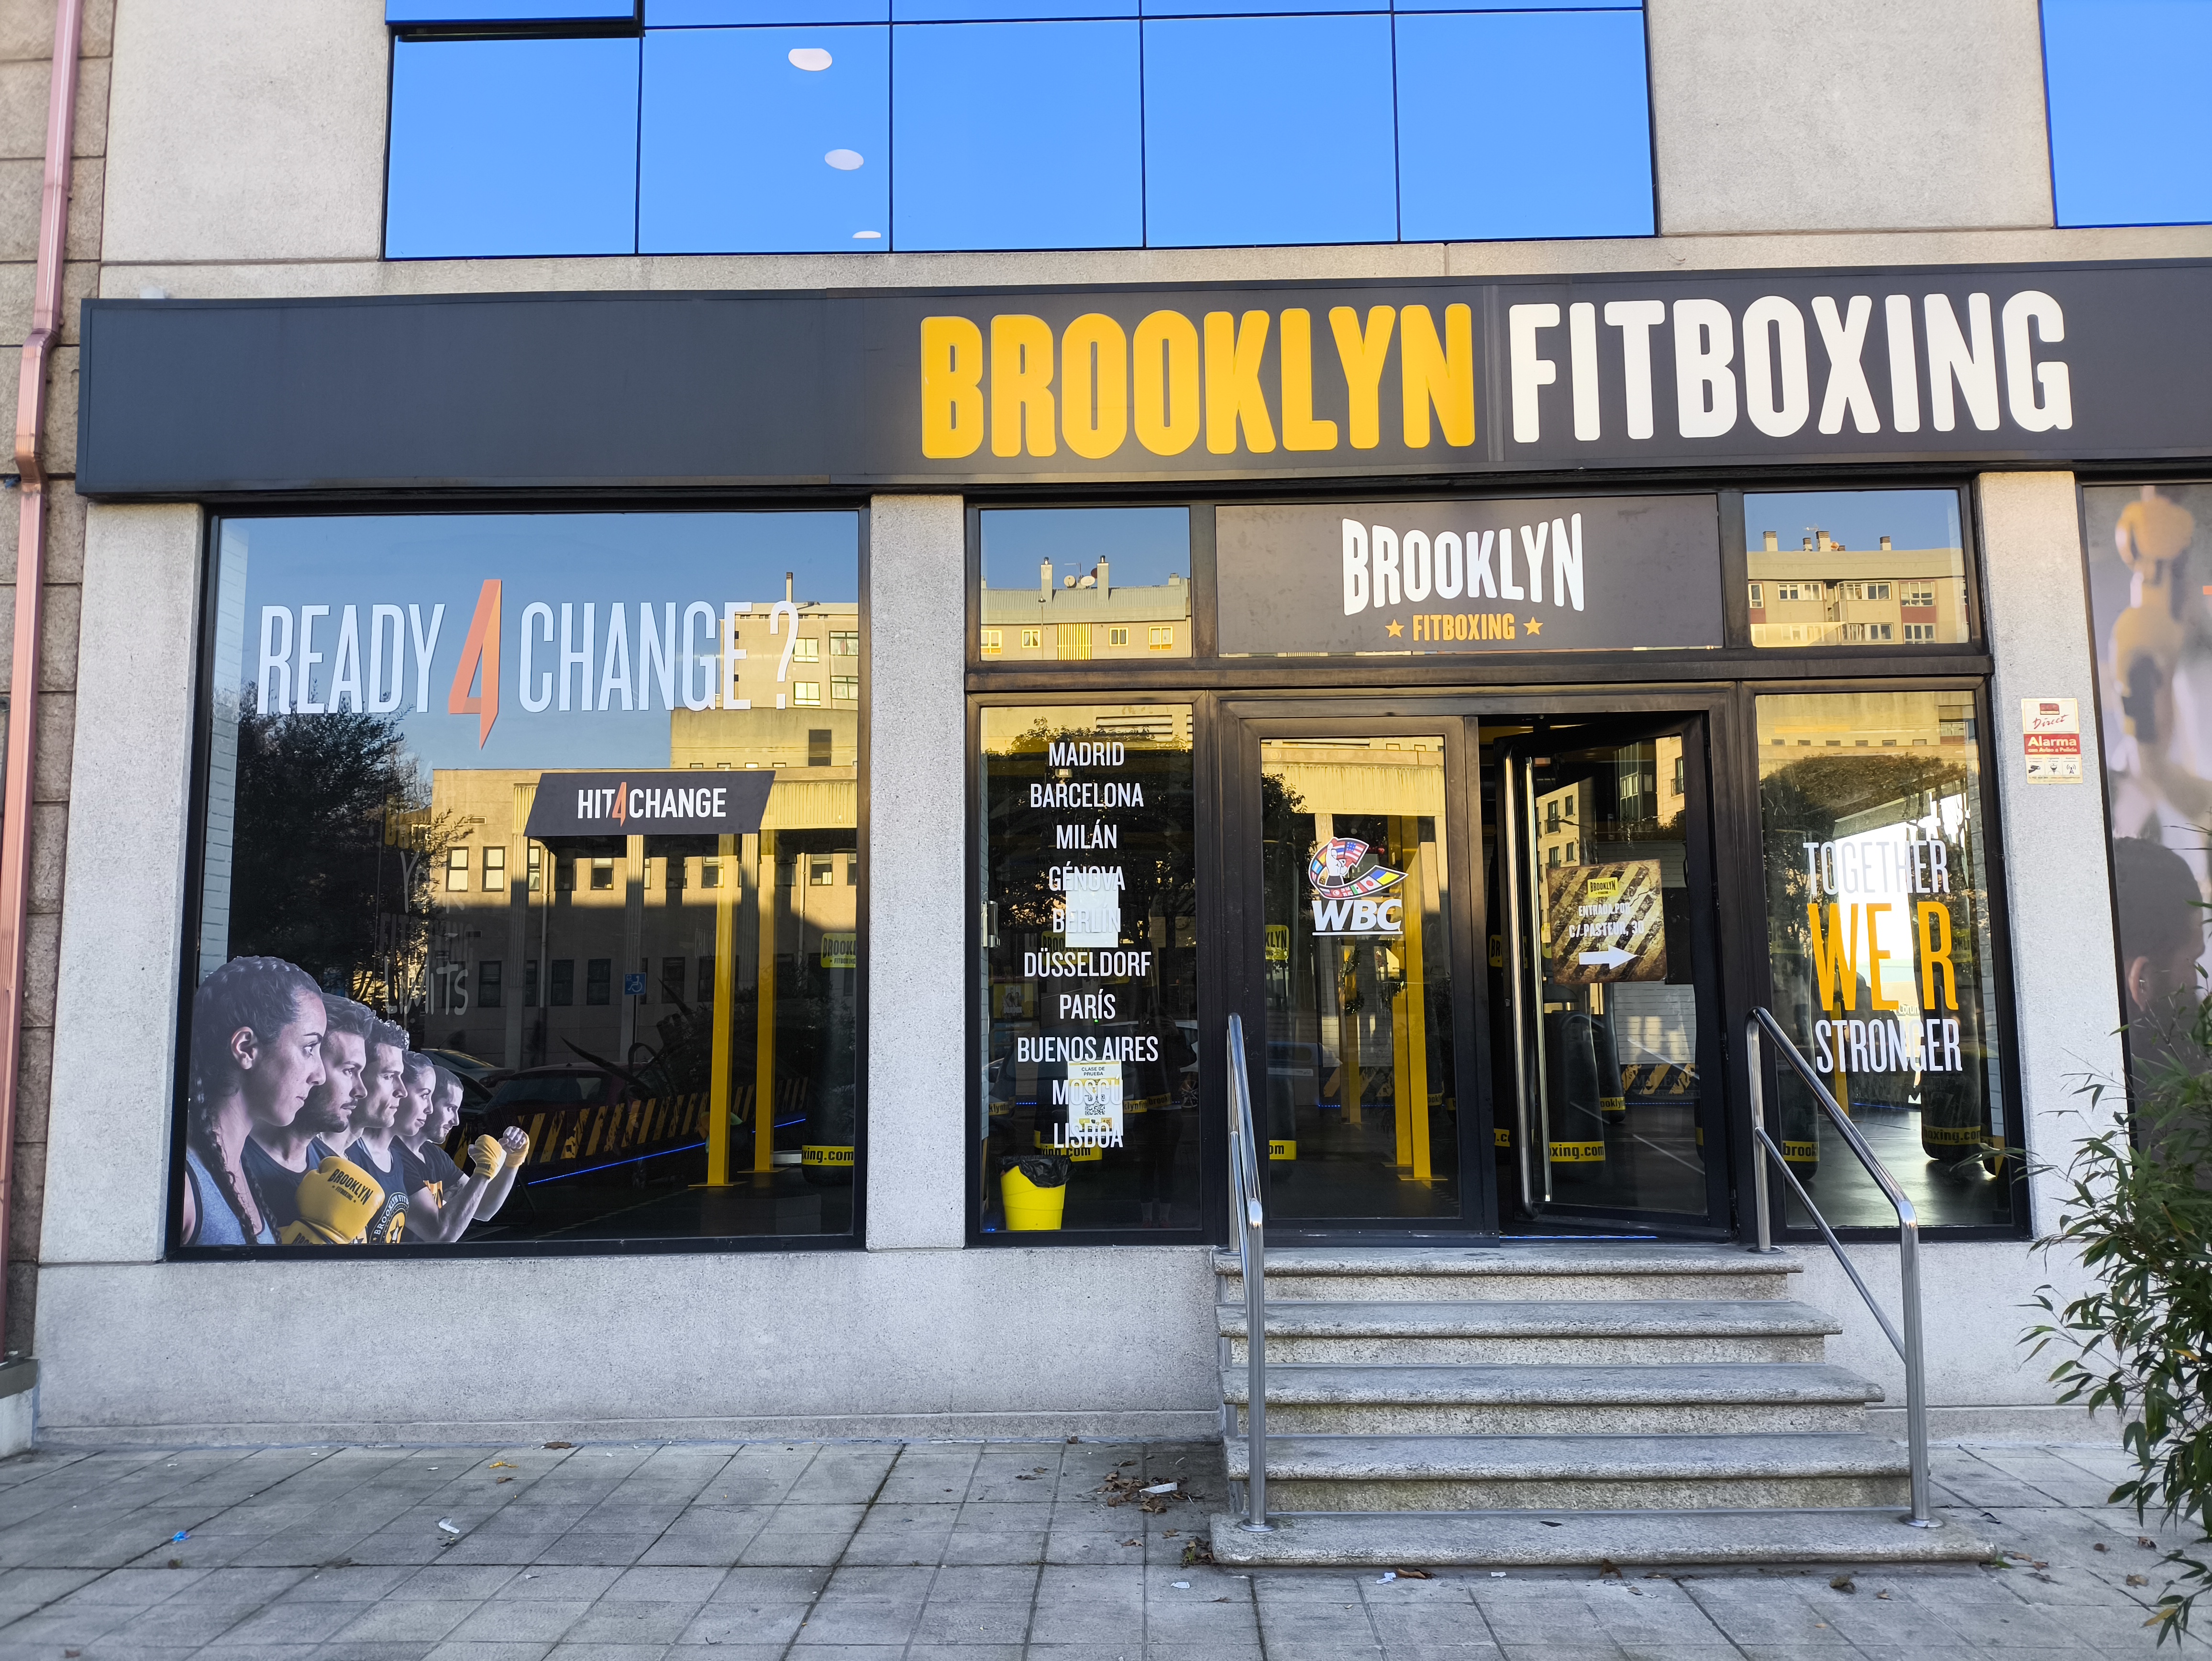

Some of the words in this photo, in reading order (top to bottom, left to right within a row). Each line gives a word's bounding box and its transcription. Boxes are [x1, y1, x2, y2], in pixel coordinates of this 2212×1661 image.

[921, 303, 1475, 459] BROOKLYN
[1509, 290, 2073, 443] FITBOXING
[1342, 513, 1583, 615] BROOKLYN
[1413, 613, 1515, 641] FITBOXING
[257, 604, 445, 715] READY
[448, 579, 502, 750] 4
[519, 601, 752, 712] CHANGE
[2033, 714, 2070, 729] Direct
[1049, 742, 1124, 766] MADRID
[2028, 736, 2076, 746] Alarma
[1030, 783, 1143, 808] BARCELONA
[1056, 819, 1117, 849] MILÁN
[1049, 861, 1125, 891] GÉNOVA
[1803, 841, 1950, 895] TOGETHER
[1590, 880, 1616, 893] BROOKLYN
[1053, 904, 1121, 932] BERLÍN
[1312, 899, 1402, 930] WBC
[1578, 903, 1613, 917] ENTRADA
[1615, 902, 1630, 915] POR
[1632, 920, 1645, 934] 30
[1025, 948, 1151, 977] DÜSSELDORF
[1807, 903, 1898, 1011] WE
[1917, 901, 1958, 1010] R
[1060, 989, 1116, 1019] PARÍS
[1018, 1037, 1096, 1062] BUENOS
[1102, 1036, 1158, 1062] AIRES
[1815, 1019, 1962, 1073] STRONGER
[1053, 1074, 1123, 1105] MOSCÚ
[1054, 1123, 1123, 1148] LISBOA
[328, 1169, 373, 1205] BROOKLYN
[374, 1195, 398, 1235] BROOKLYN
